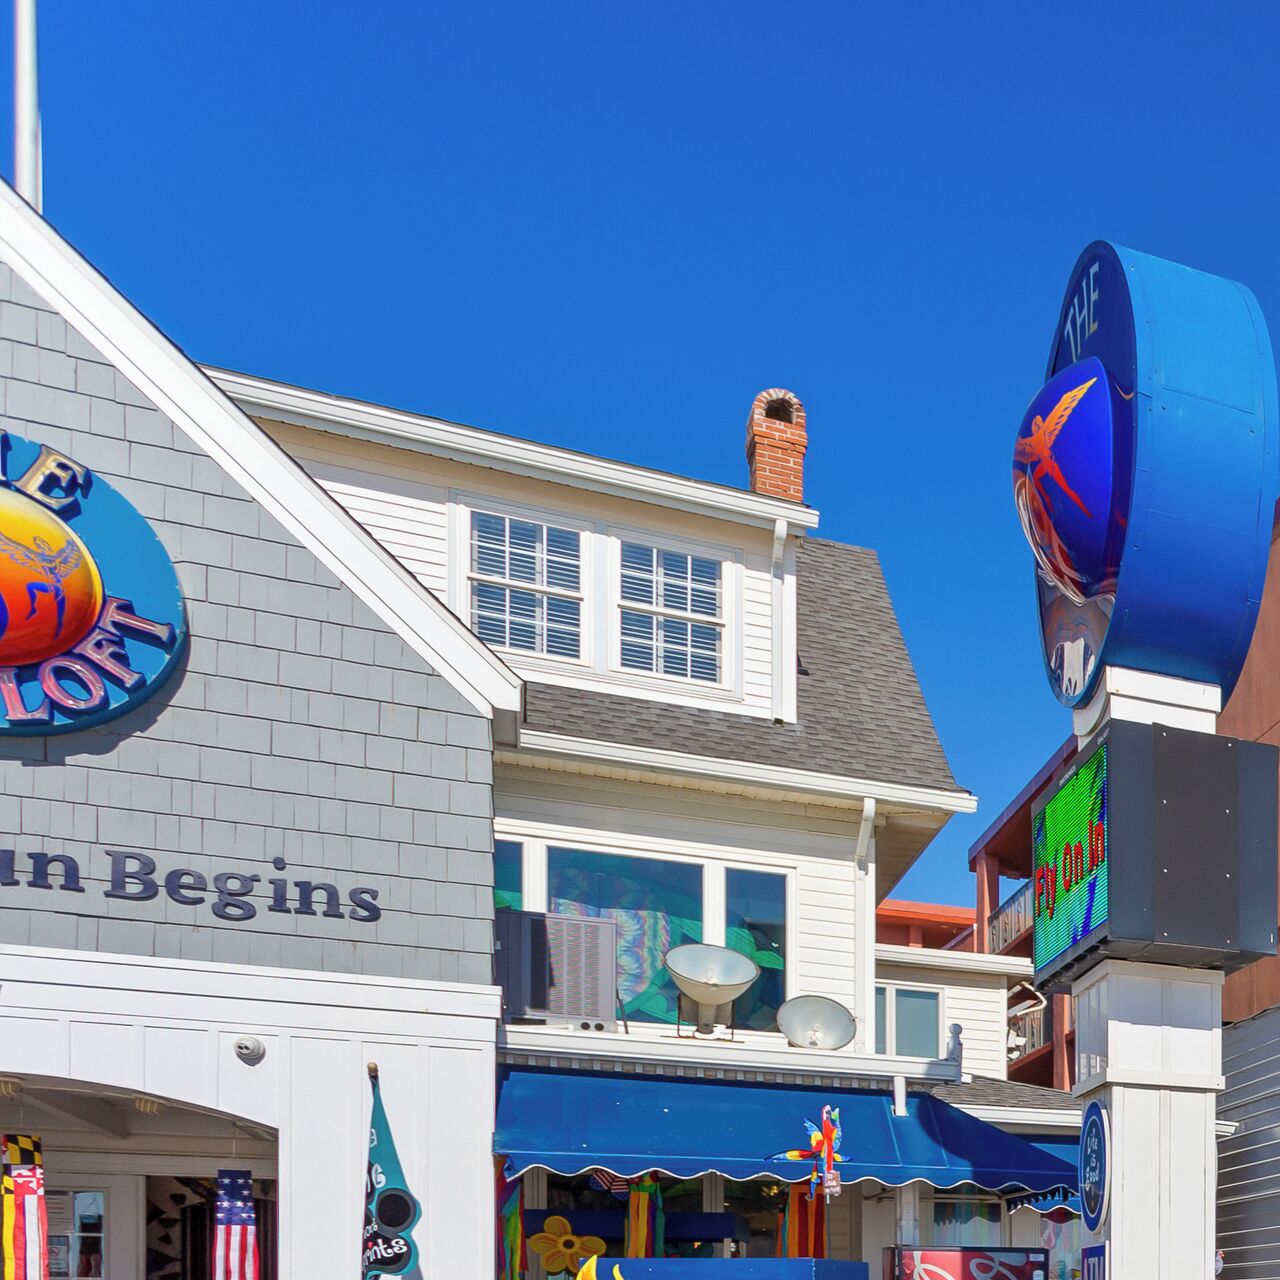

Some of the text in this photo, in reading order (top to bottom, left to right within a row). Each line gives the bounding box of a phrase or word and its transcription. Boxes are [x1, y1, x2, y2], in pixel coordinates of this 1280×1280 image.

[1063, 262, 1099, 364] THE
[0, 596, 176, 728] LOFT
[103, 849, 382, 923] Begins
[1034, 861, 1057, 919] Fly
